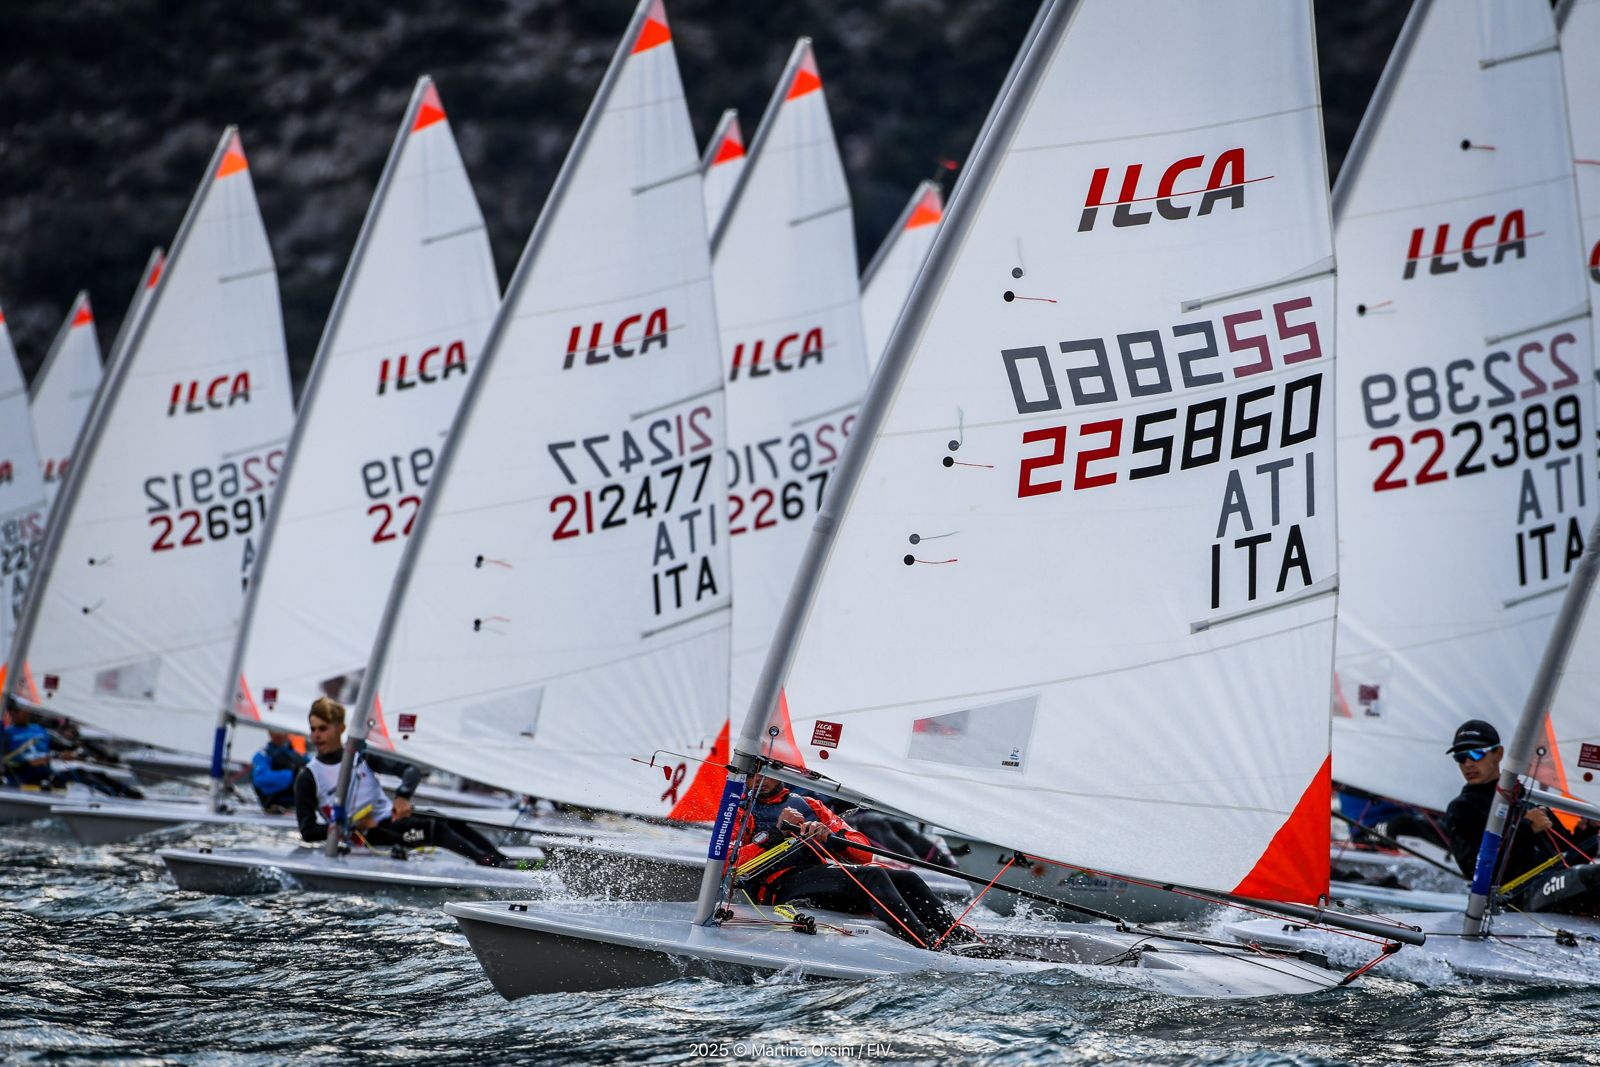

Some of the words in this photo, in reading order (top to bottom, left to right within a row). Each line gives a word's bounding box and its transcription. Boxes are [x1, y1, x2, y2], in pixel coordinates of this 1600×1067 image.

[1078, 148, 1245, 232] ILCA
[1403, 209, 1526, 280] ILCA
[377, 341, 468, 397] ILCA
[562, 307, 668, 370] ILCA
[729, 327, 823, 382] ILCA
[167, 371, 251, 417] ILCA
[1018, 373, 1323, 498] 225860
[1369, 394, 1583, 492] 222389
[549, 454, 713, 541] 212477
[1211, 524, 1313, 609] ITA
[1516, 516, 1585, 586] ITA
[653, 556, 718, 615] ITA
[816, 723, 833, 731] ILCA
[1543, 876, 1566, 896] Gill
